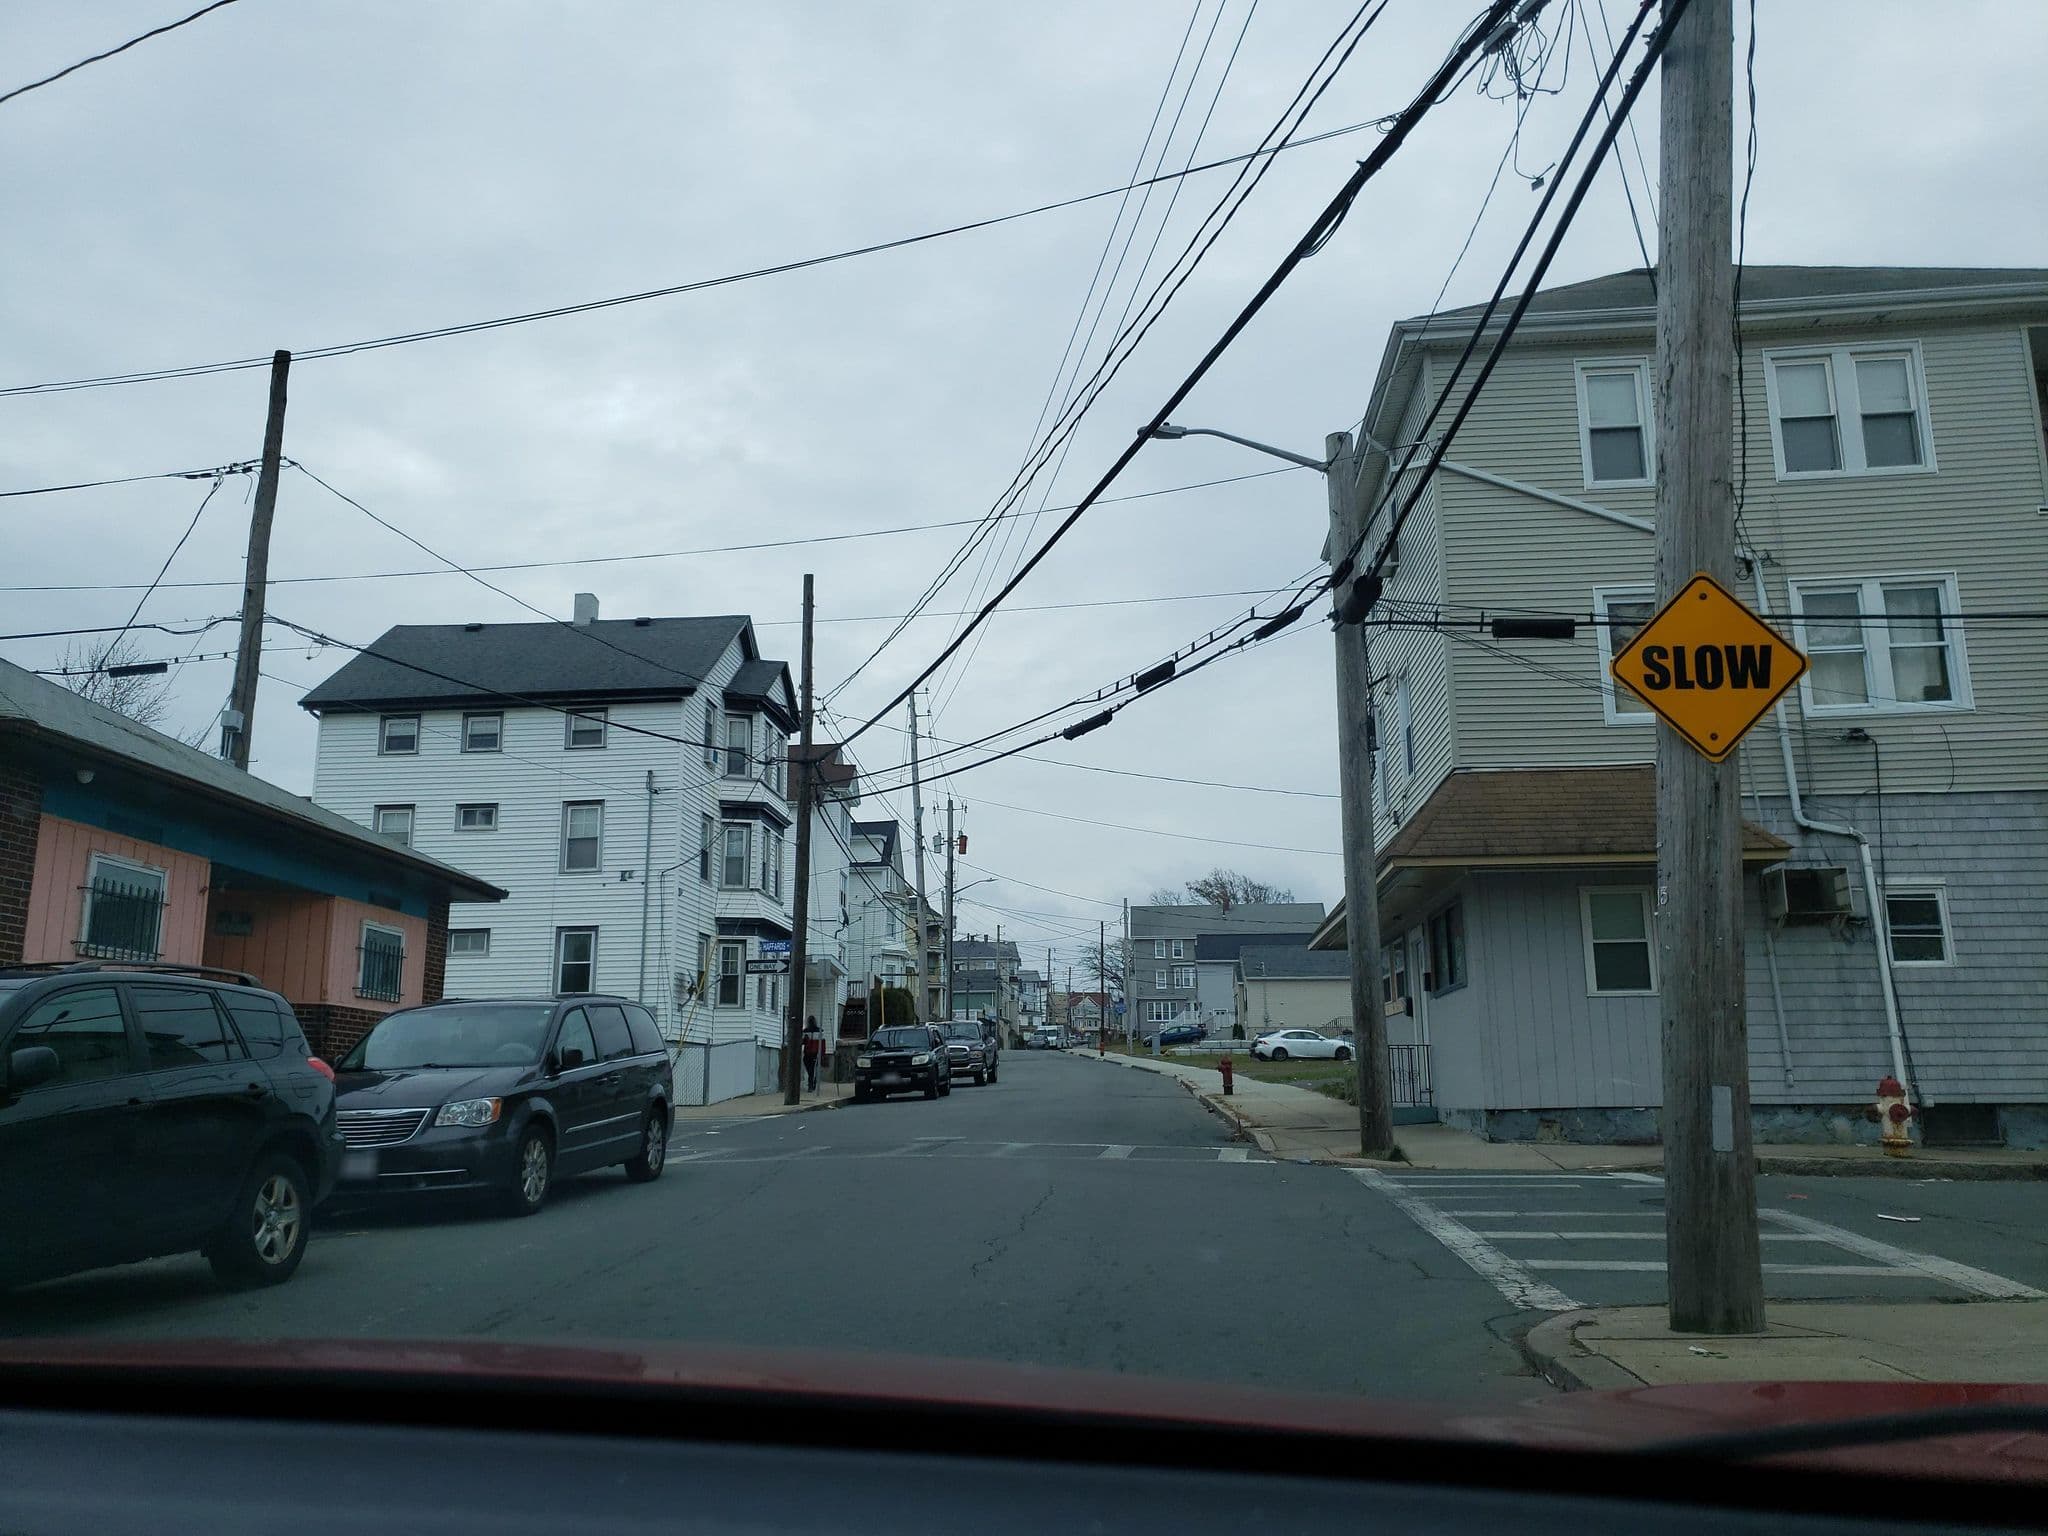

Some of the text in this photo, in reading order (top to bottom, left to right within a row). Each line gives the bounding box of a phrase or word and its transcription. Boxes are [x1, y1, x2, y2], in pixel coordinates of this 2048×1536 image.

[1641, 644, 1773, 691] SLOW
[750, 962, 776, 970] ONE WAY
